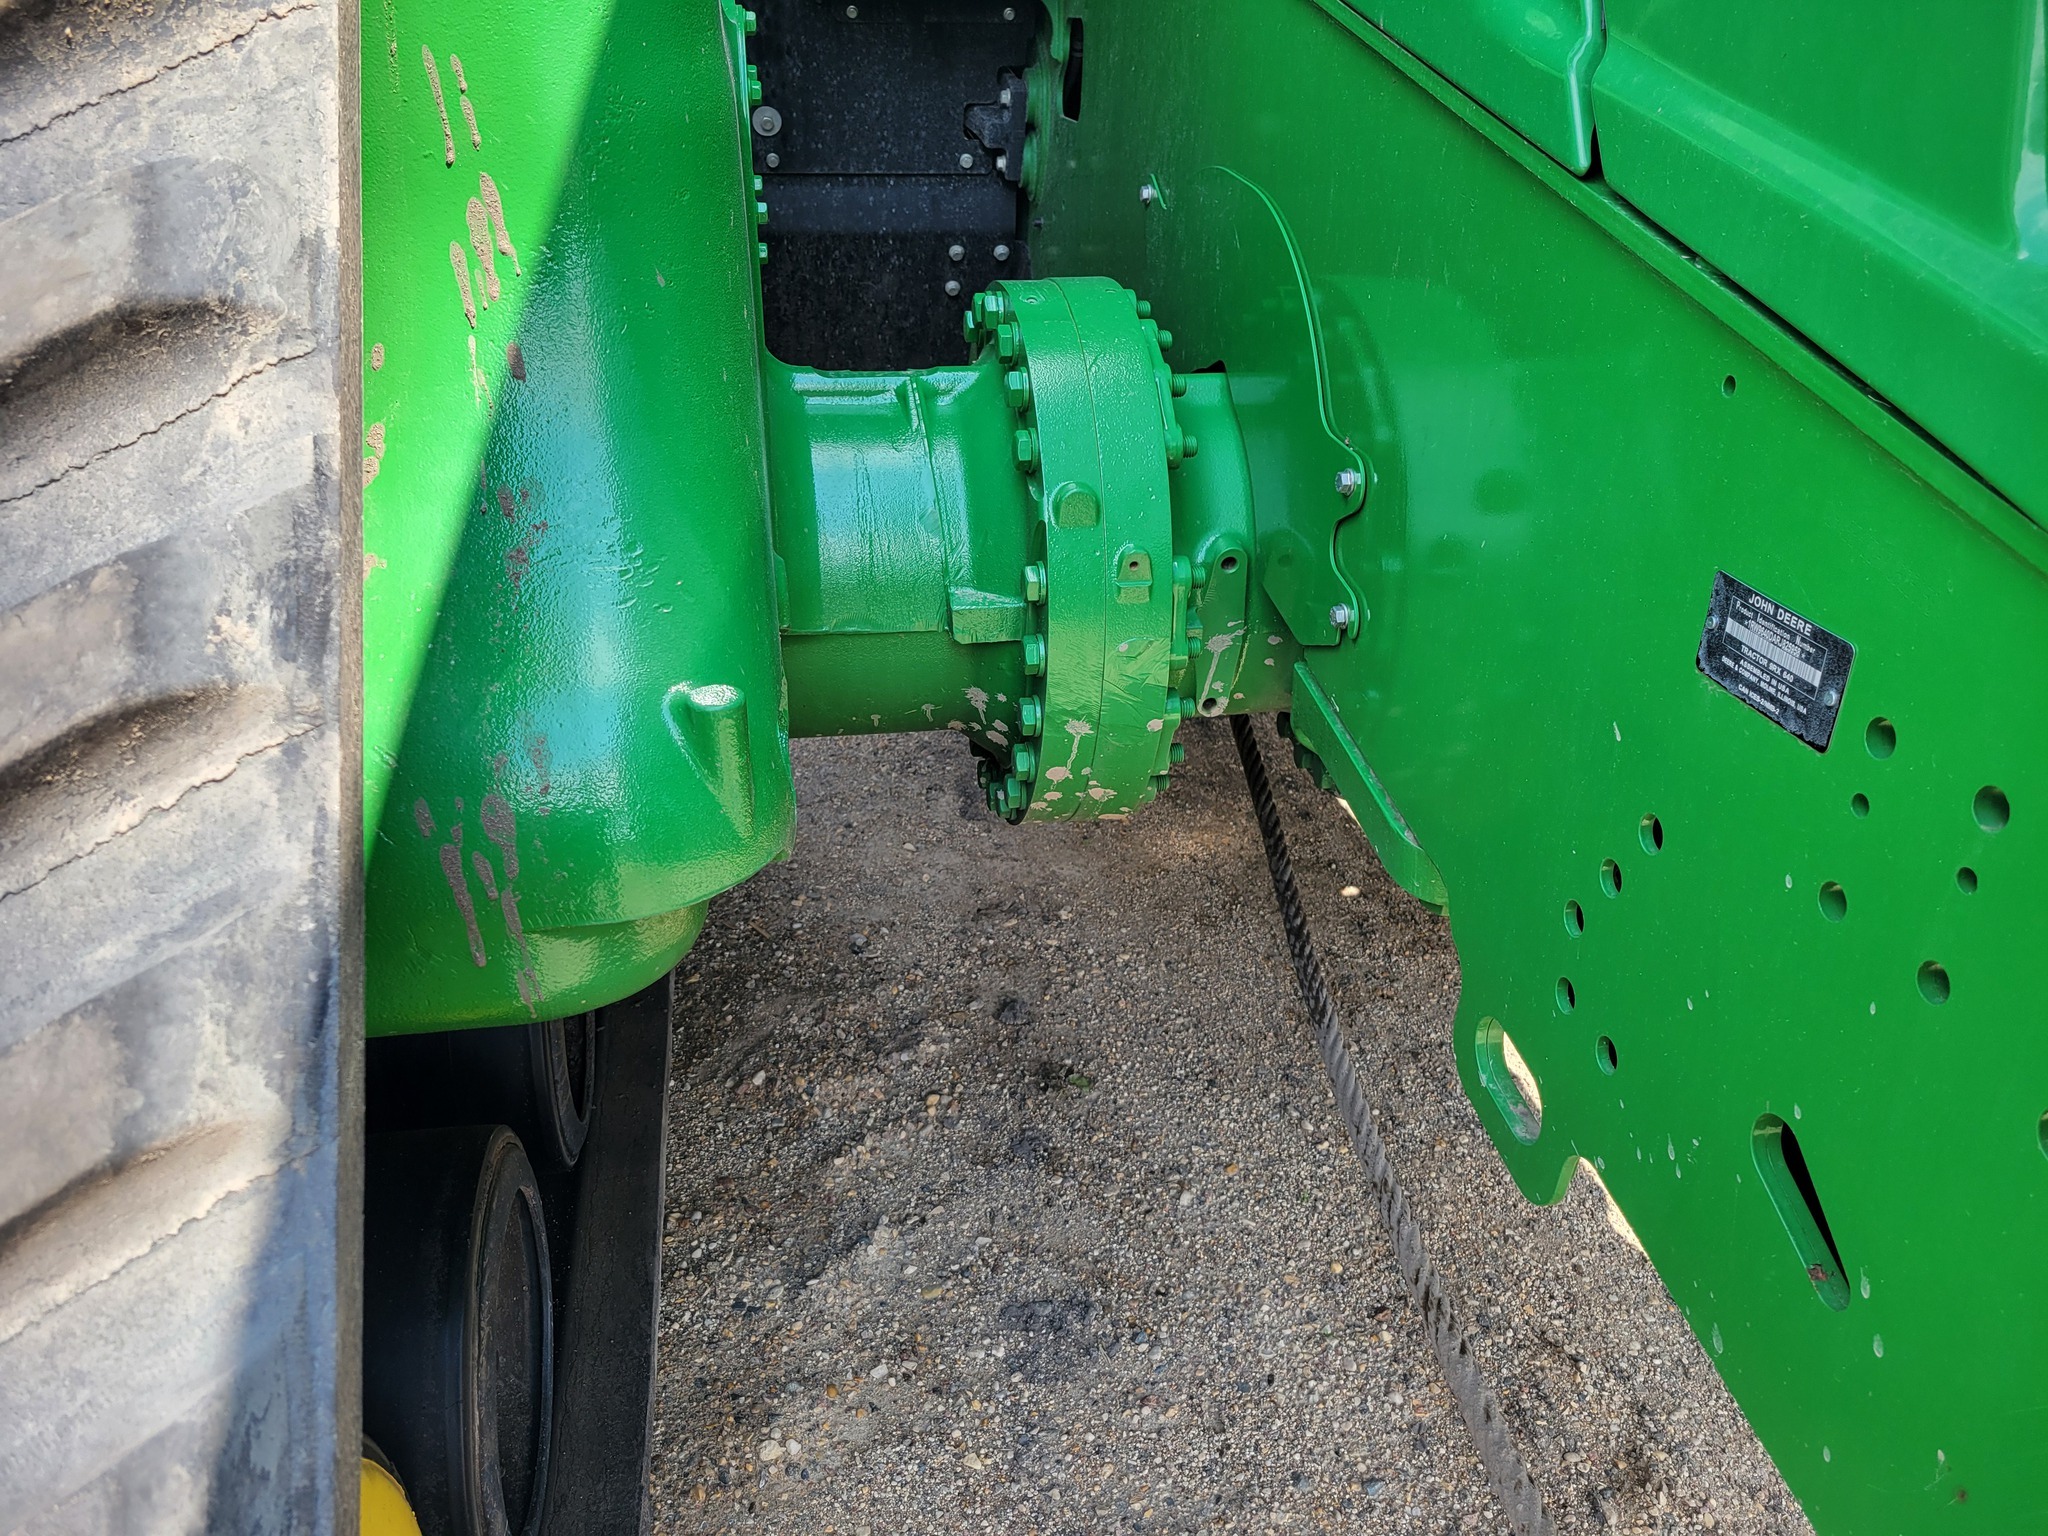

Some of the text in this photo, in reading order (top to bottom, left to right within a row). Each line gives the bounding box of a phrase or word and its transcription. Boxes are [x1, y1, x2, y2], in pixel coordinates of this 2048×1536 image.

[1735, 600, 1816, 655] Product Identification Number
[1748, 593, 1812, 637] JOHN DEERE
[1739, 658, 1790, 695] ASSEMBLED IN USA
[1740, 644, 1794, 683] TRACTOR 9RX 640
[1721, 654, 1734, 668] DEERE
[1796, 702, 1807, 715] USA
[1737, 682, 1749, 695] CAN
